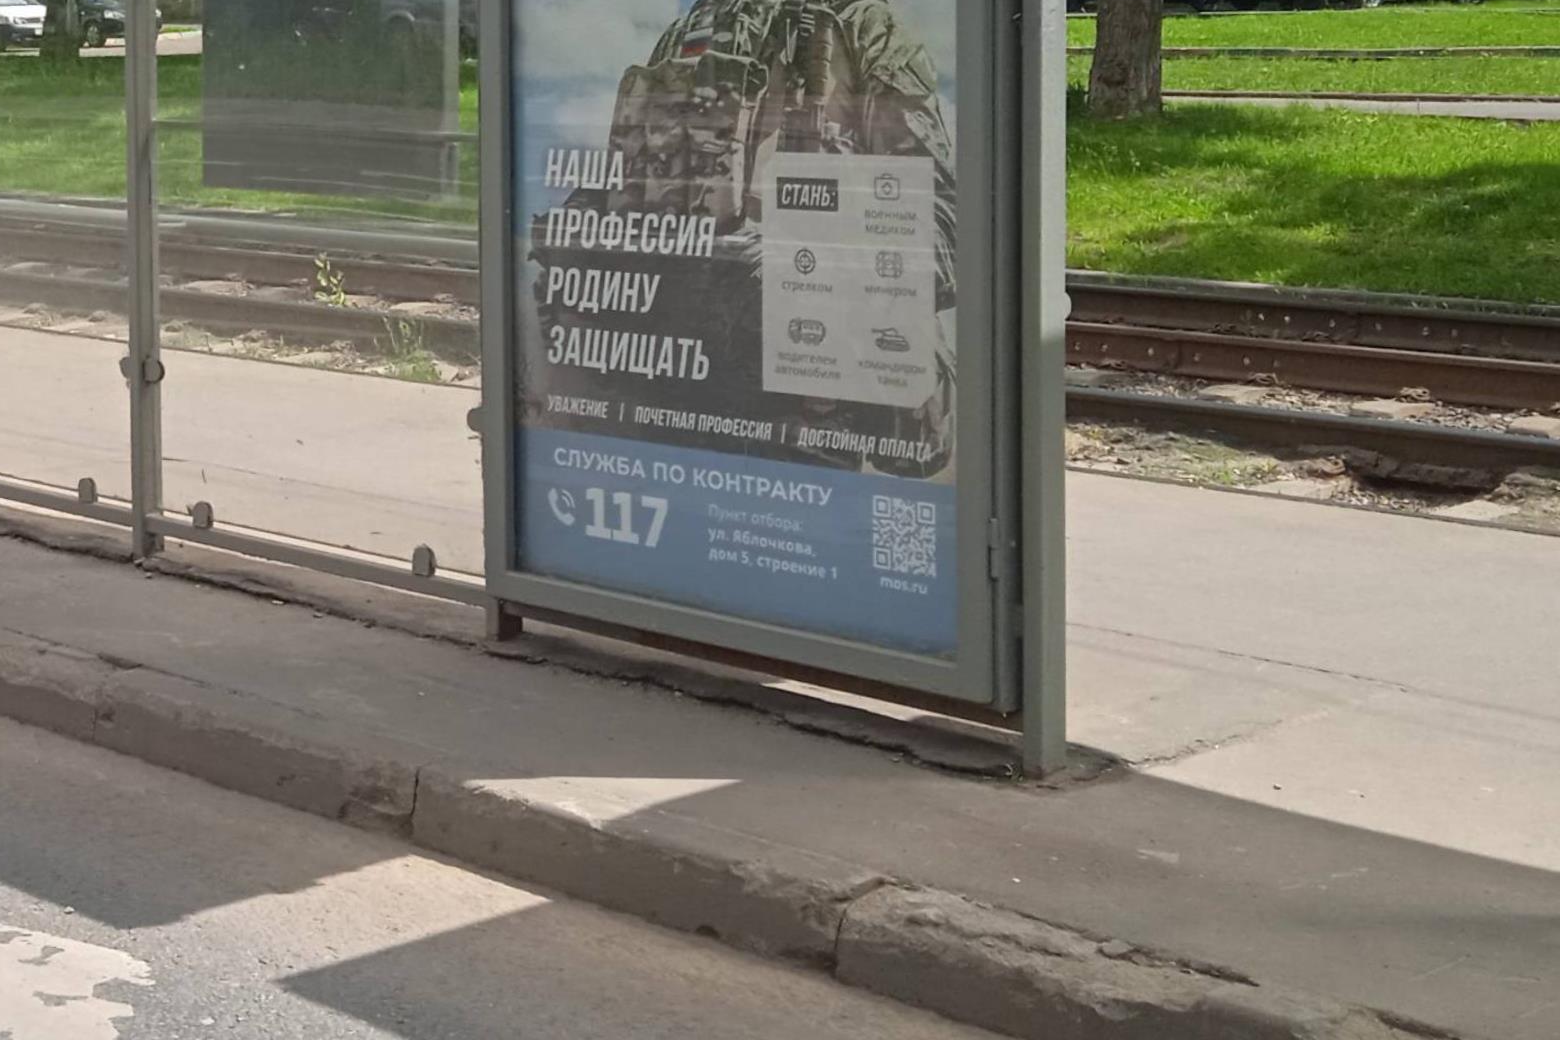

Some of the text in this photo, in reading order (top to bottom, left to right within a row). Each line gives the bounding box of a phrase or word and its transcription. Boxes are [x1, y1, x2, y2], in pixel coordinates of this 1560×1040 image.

[544, 148, 624, 191] НАША
[781, 183, 837, 207] СТАНЬ:
[545, 207, 717, 258] ПРОФЕССИЯ
[546, 266, 661, 314] РОДИНУ
[547, 325, 711, 381] ЗАЩИЩАТЬ
[547, 394, 609, 419] УВАЖЕНИЕ
[634, 406, 773, 441] ПОЧЕТНАЯ ПРОФЕССИЯ
[797, 427, 933, 462] ДОСТОЙНАЯ ОПЛАТА
[553, 447, 833, 506] СЛУЖБА ПО КОНТРАКТУ
[585, 487, 669, 548] 117
[707, 503, 747, 524] Пункт
[708, 528, 817, 557] ул. Яблочкова,
[708, 548, 737, 562] дом
[756, 556, 826, 579] строение
[830, 566, 838, 579] 1
[880, 576, 929, 595] mos.ru
